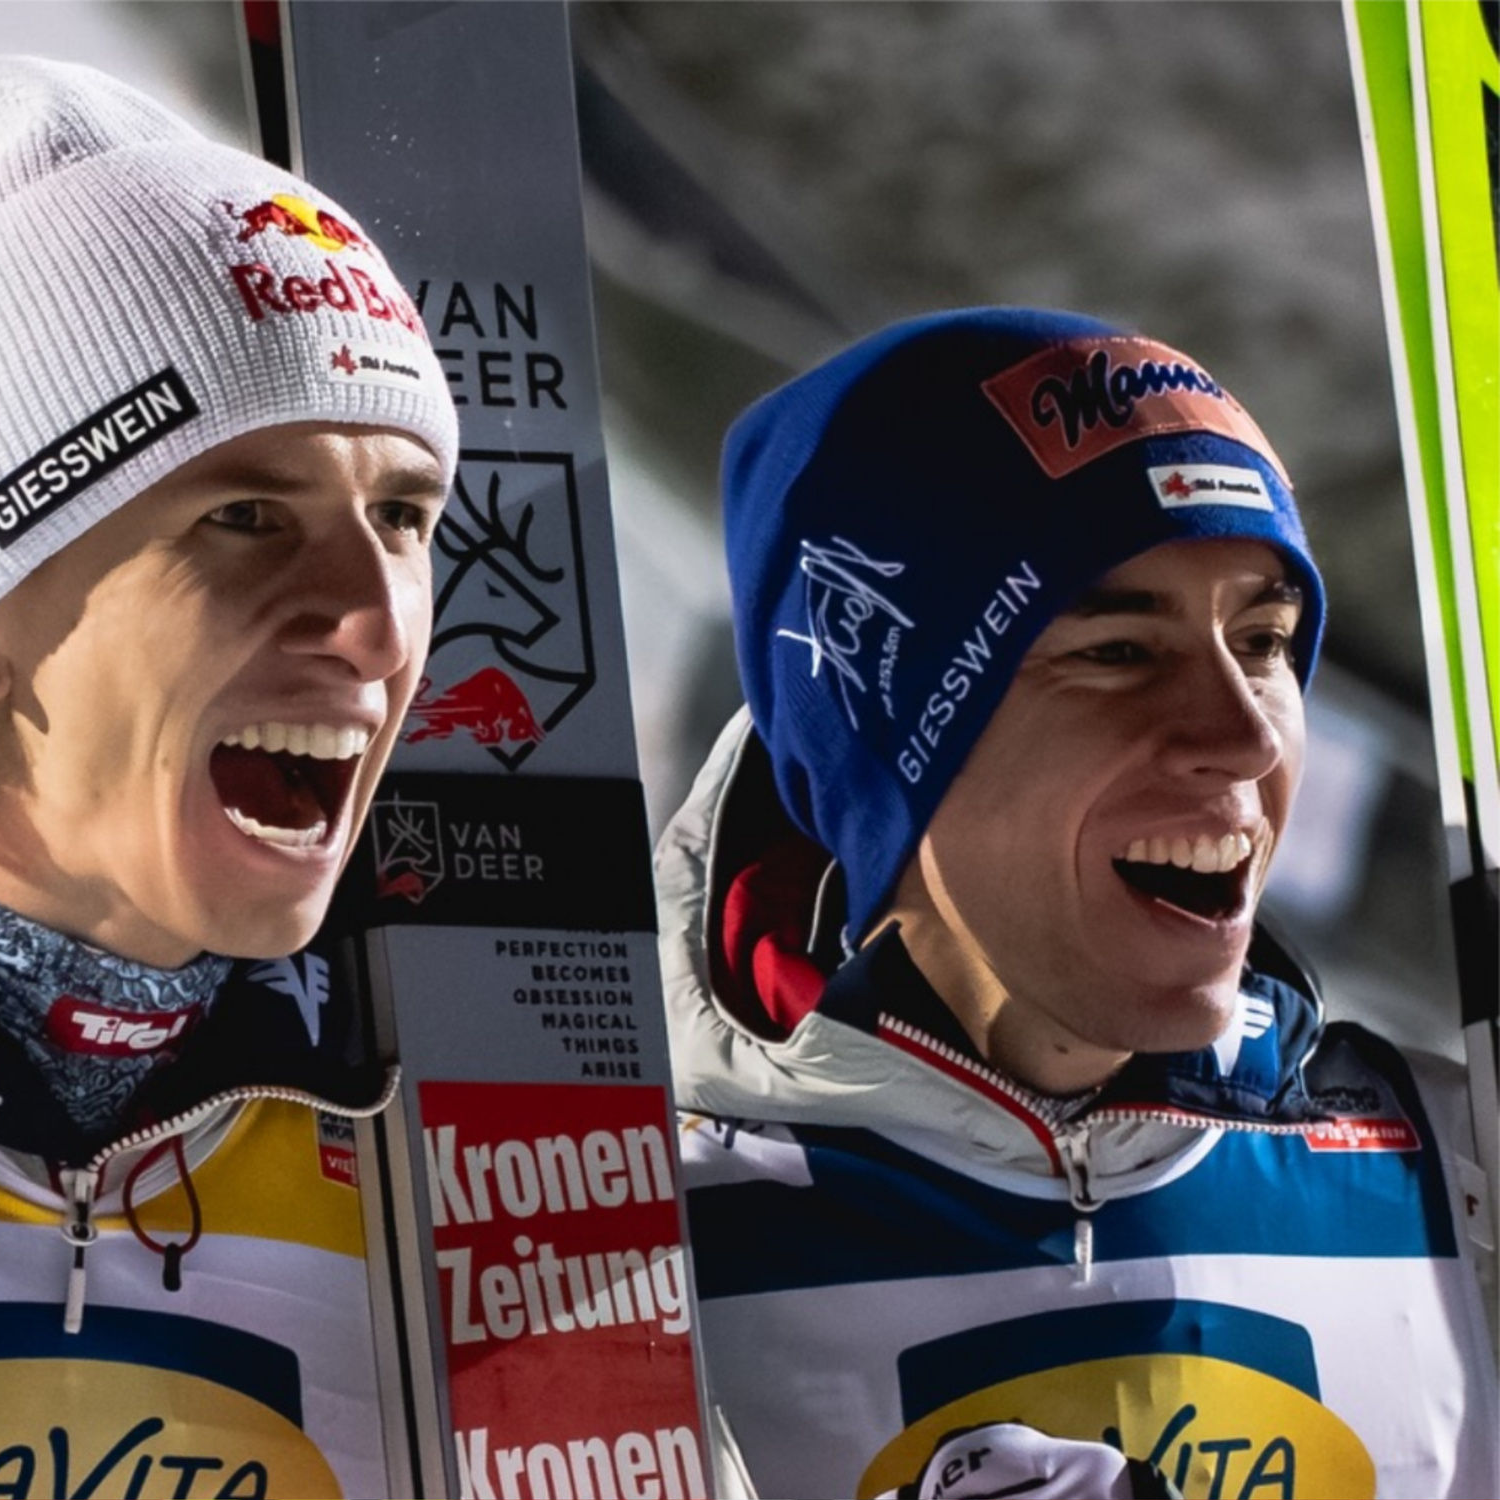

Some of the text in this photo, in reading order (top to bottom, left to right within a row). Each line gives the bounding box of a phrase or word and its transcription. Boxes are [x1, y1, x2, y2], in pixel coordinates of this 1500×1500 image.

[230, 258, 360, 321] Red
[434, 349, 568, 409] EER
[899, 560, 1042, 785] GIESSWEIN
[450, 824, 522, 849] VAN
[455, 853, 544, 881] DEER
[495, 940, 628, 958] PERFECTION
[532, 965, 631, 983] BECOMES
[513, 988, 634, 1006] OBSESSION
[71, 1011, 188, 1049] Tirol
[541, 1013, 638, 1031] MAGICAL
[561, 1037, 639, 1055] THINGS
[581, 1062, 642, 1078] ARISE
[423, 1124, 675, 1227] Kronen
[435, 1235, 692, 1345] Zeitung
[454, 1425, 707, 1500] Kronen
